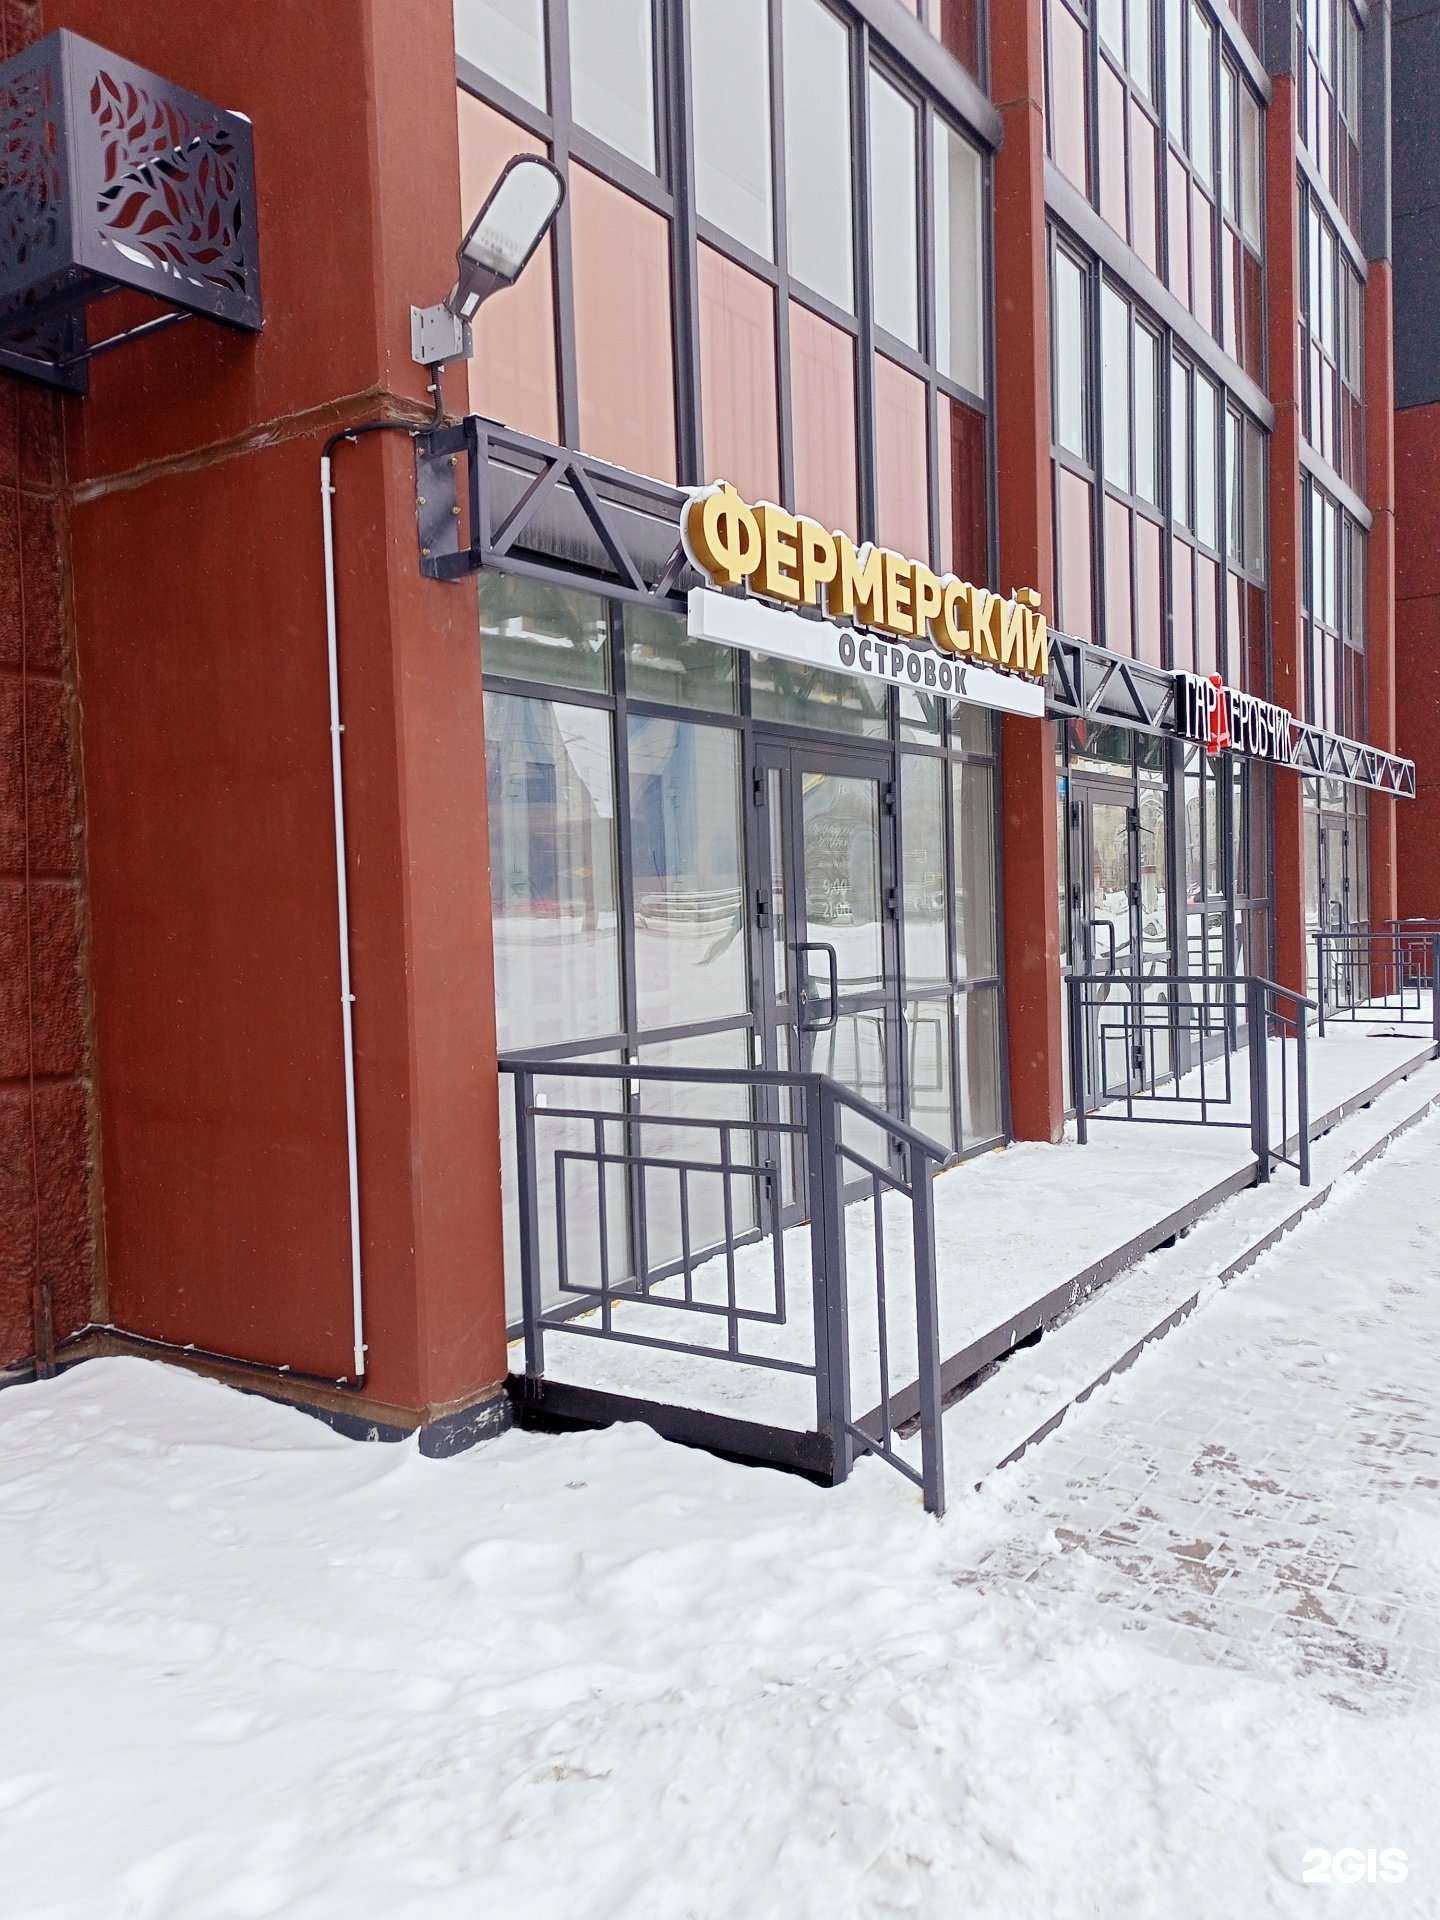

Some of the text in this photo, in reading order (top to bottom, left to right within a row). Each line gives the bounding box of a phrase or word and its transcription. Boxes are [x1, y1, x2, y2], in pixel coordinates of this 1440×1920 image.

[694, 482, 1048, 676] ФЕРМЕРСКИЙ
[838, 633, 968, 696] ОСТРОВОК
[1185, 673, 1293, 763] ГАРДЕРОБЧИК
